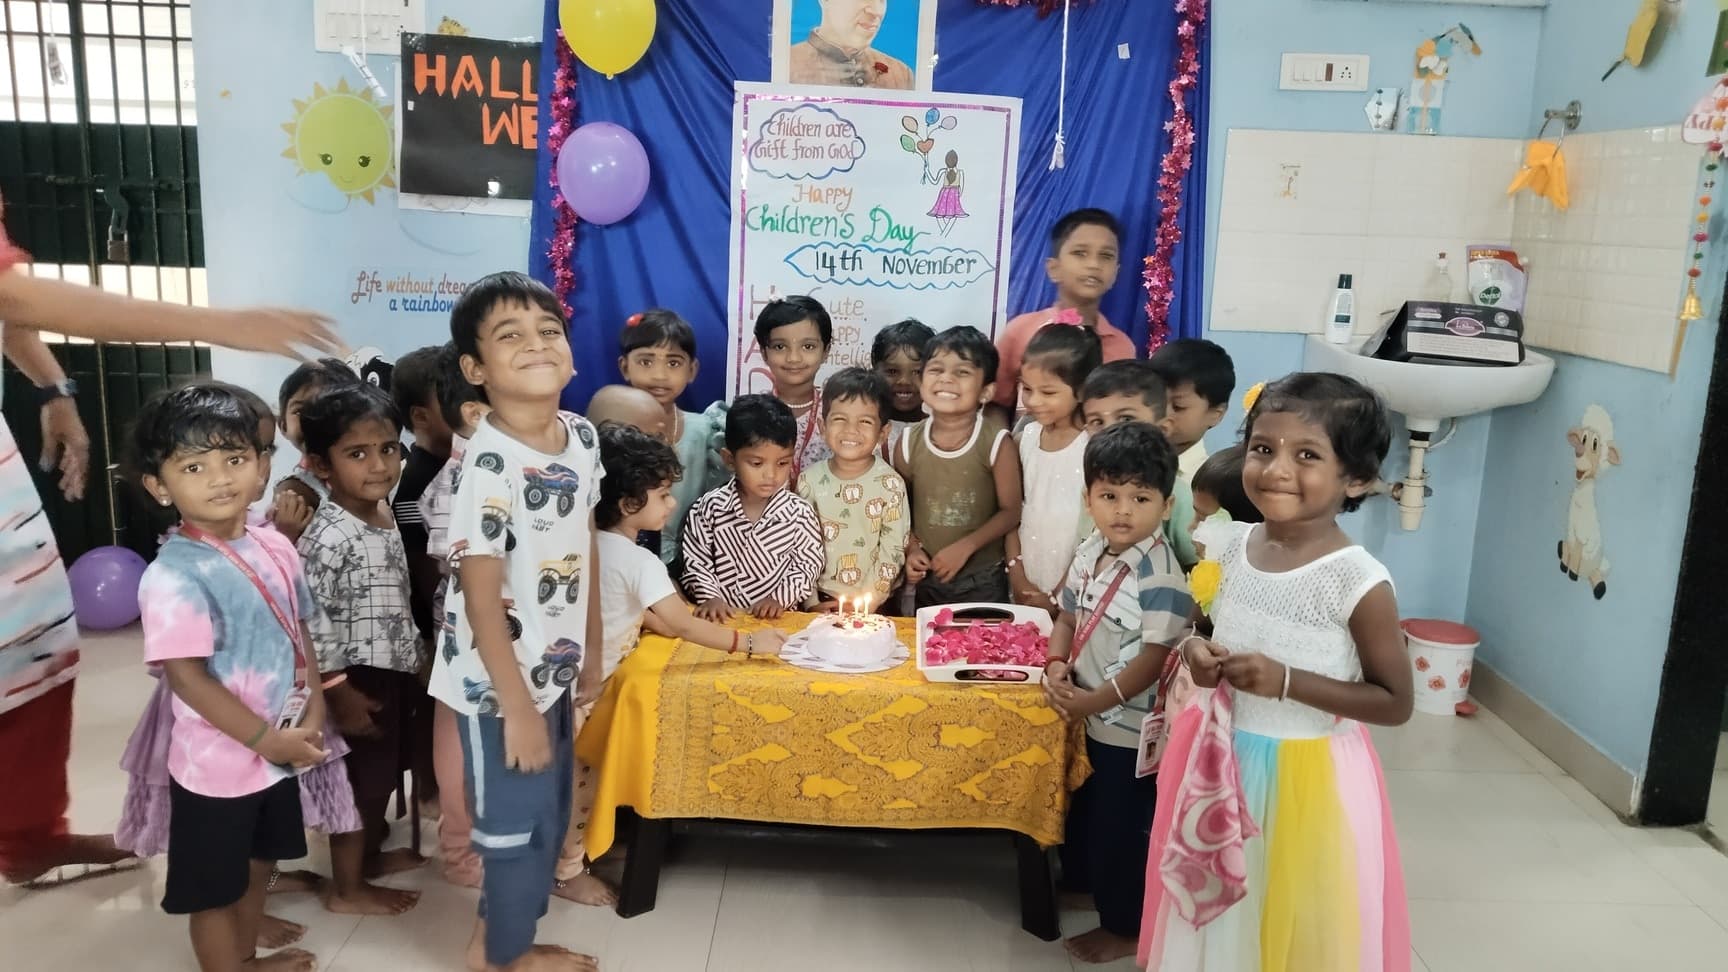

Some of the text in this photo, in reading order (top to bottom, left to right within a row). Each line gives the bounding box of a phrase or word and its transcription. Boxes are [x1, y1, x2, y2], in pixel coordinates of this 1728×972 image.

[767, 113, 853, 138] Children are
[754, 138, 788, 160] Gift
[791, 138, 825, 160] from
[791, 183, 853, 212] Happy
[745, 204, 931, 253] Children's Day
[815, 250, 978, 277] 14th November
[351, 270, 467, 305] Life without drea
[389, 298, 398, 312] a
